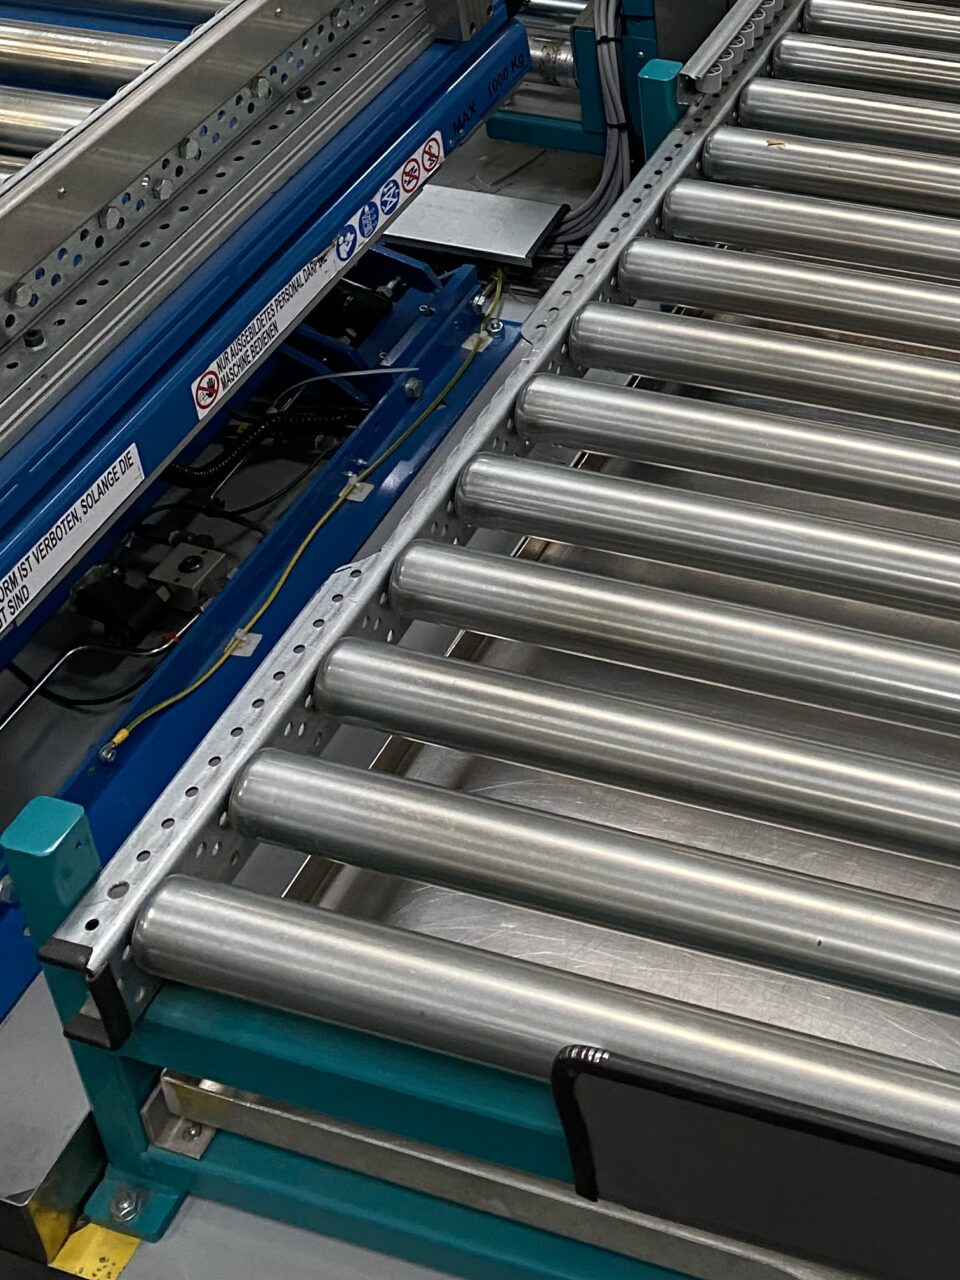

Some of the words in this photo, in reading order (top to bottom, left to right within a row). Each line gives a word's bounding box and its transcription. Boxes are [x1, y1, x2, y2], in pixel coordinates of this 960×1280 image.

[487, 67, 509, 97] 1000
[216, 351, 231, 374] NUR
[230, 303, 277, 360] AUSGEBILDETES
[274, 277, 304, 315] PERSONAL
[220, 352, 251, 391] MASCHINE
[250, 321, 280, 362] BEDIENEN
[17, 555, 33, 582] IST
[31, 508, 83, 564] VERBOTEN,
[80, 465, 120, 515] SOLANGE
[119, 450, 134, 474] DIE
[7, 584, 30, 616] SIND
